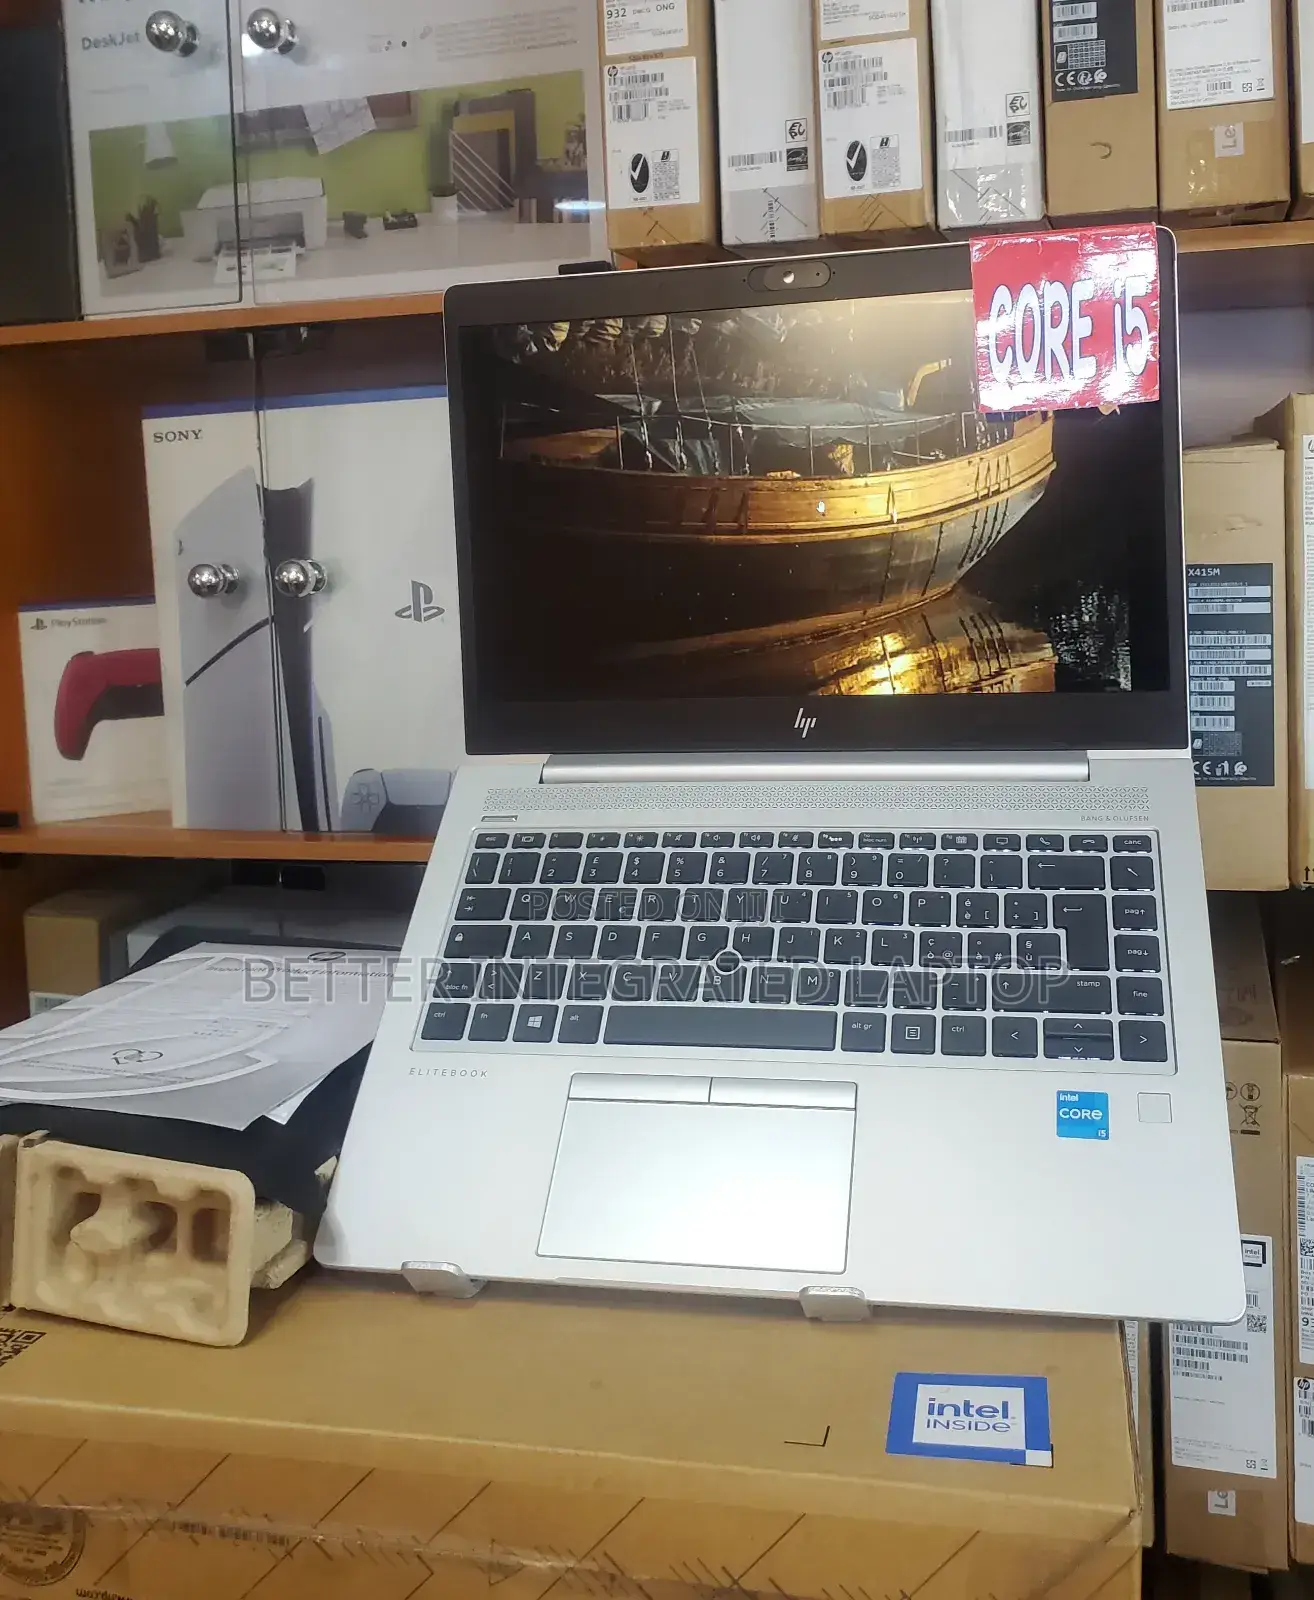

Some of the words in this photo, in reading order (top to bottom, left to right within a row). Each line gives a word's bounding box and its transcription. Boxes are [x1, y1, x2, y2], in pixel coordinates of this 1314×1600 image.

[81, 31, 141, 51] DeskJet
[988, 279, 1098, 383] CORE
[152, 429, 203, 444] SONY
[1188, 568, 1221, 577] X415M
[547, 869, 555, 877] 2
[589, 868, 597, 877] 3
[631, 869, 638, 877] 4
[674, 869, 681, 877] 5
[716, 869, 724, 877] 6
[761, 869, 768, 877] 7
[805, 869, 813, 878] 8
[850, 870, 858, 878] 9
[521, 894, 531, 903] Q
[564, 894, 577, 903] W
[605, 894, 612, 903] E
[648, 894, 656, 903] R
[691, 894, 699, 903] T
[736, 895, 744, 903] Y
[780, 895, 789, 904] U
[872, 897, 882, 907] O
[918, 899, 926, 907] P
[965, 899, 971, 907] é
[522, 932, 532, 941] A
[565, 932, 573, 941] S
[608, 932, 617, 941] D
[651, 932, 660, 941] F
[697, 933, 706, 942] G
[741, 933, 750, 943] H
[787, 934, 794, 944] J
[833, 936, 842, 945] K
[881, 937, 888, 947] L
[928, 938, 935, 946] ç
[1025, 940, 1032, 949] §
[534, 972, 542, 980] Z
[578, 972, 588, 981] X
[623, 972, 632, 981] C
[669, 973, 678, 982] V
[713, 976, 722, 985] B
[760, 975, 769, 984] N
[807, 976, 818, 986] M
[1076, 980, 1101, 988] stamp
[1133, 990, 1148, 998] fine
[409, 1067, 488, 1078] ELITEBOOK
[1060, 1093, 1079, 1102] intel
[927, 1397, 1010, 1420] intel
